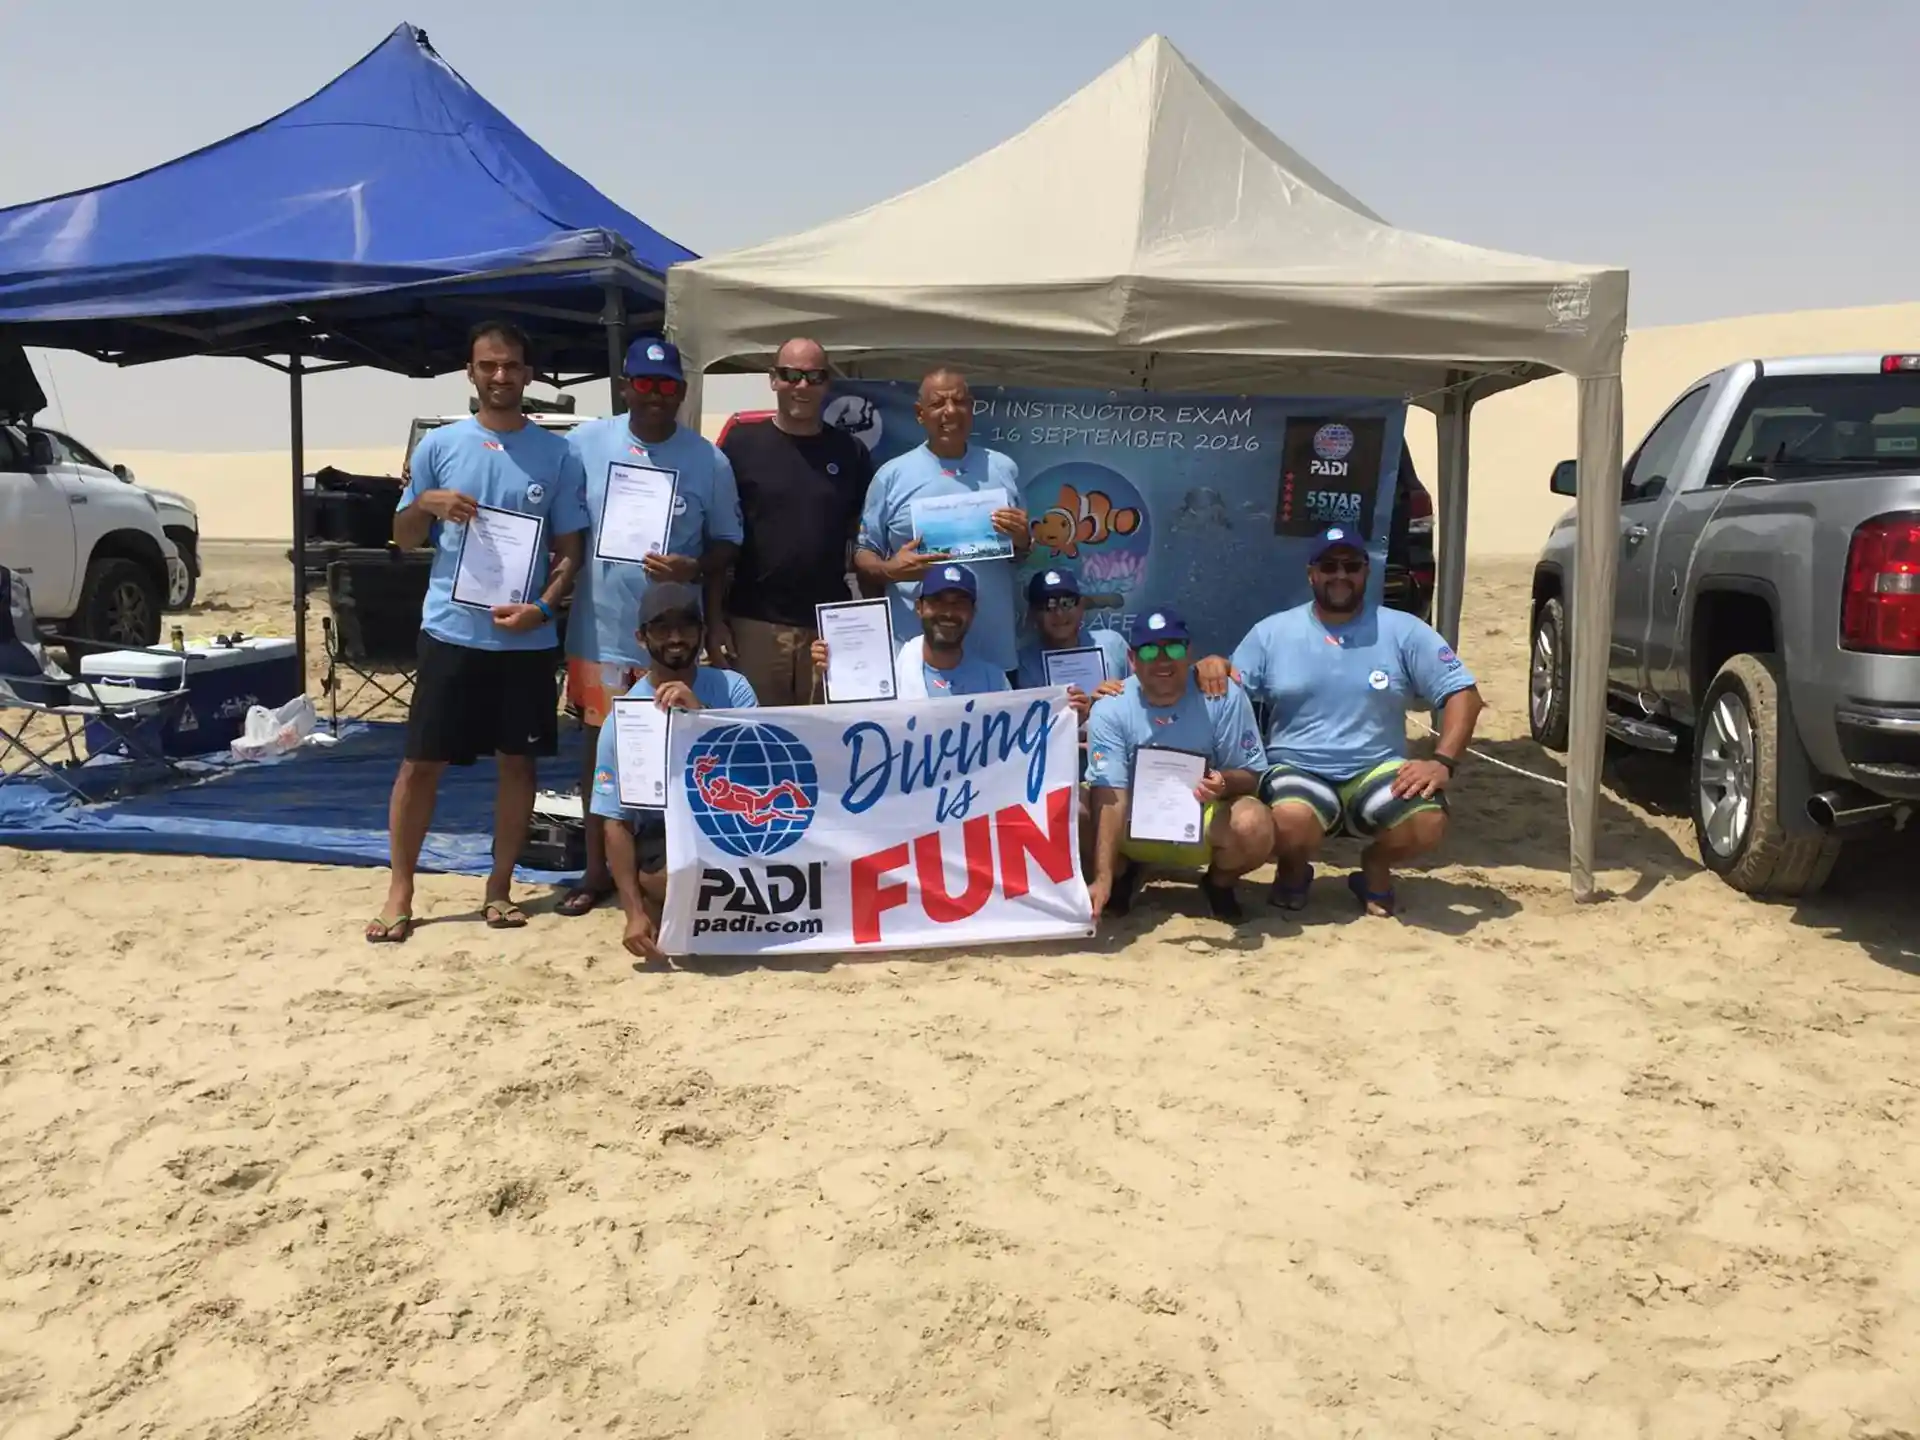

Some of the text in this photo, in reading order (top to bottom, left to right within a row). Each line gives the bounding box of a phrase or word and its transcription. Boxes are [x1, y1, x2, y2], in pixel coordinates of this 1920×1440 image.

[1006, 400, 1168, 424] INSTRUCTOR
[1176, 406, 1252, 427] EXAM
[990, 427, 1021, 443] 16
[1031, 427, 1185, 449] SEPTEMBER
[1193, 434, 1260, 451] 2016
[1310, 460, 1349, 476] PADI
[841, 698, 1058, 814] Diving
[935, 770, 979, 823] is
[851, 786, 1075, 944] FUN
[697, 862, 822, 914] PADI
[692, 914, 823, 937] padi.com
